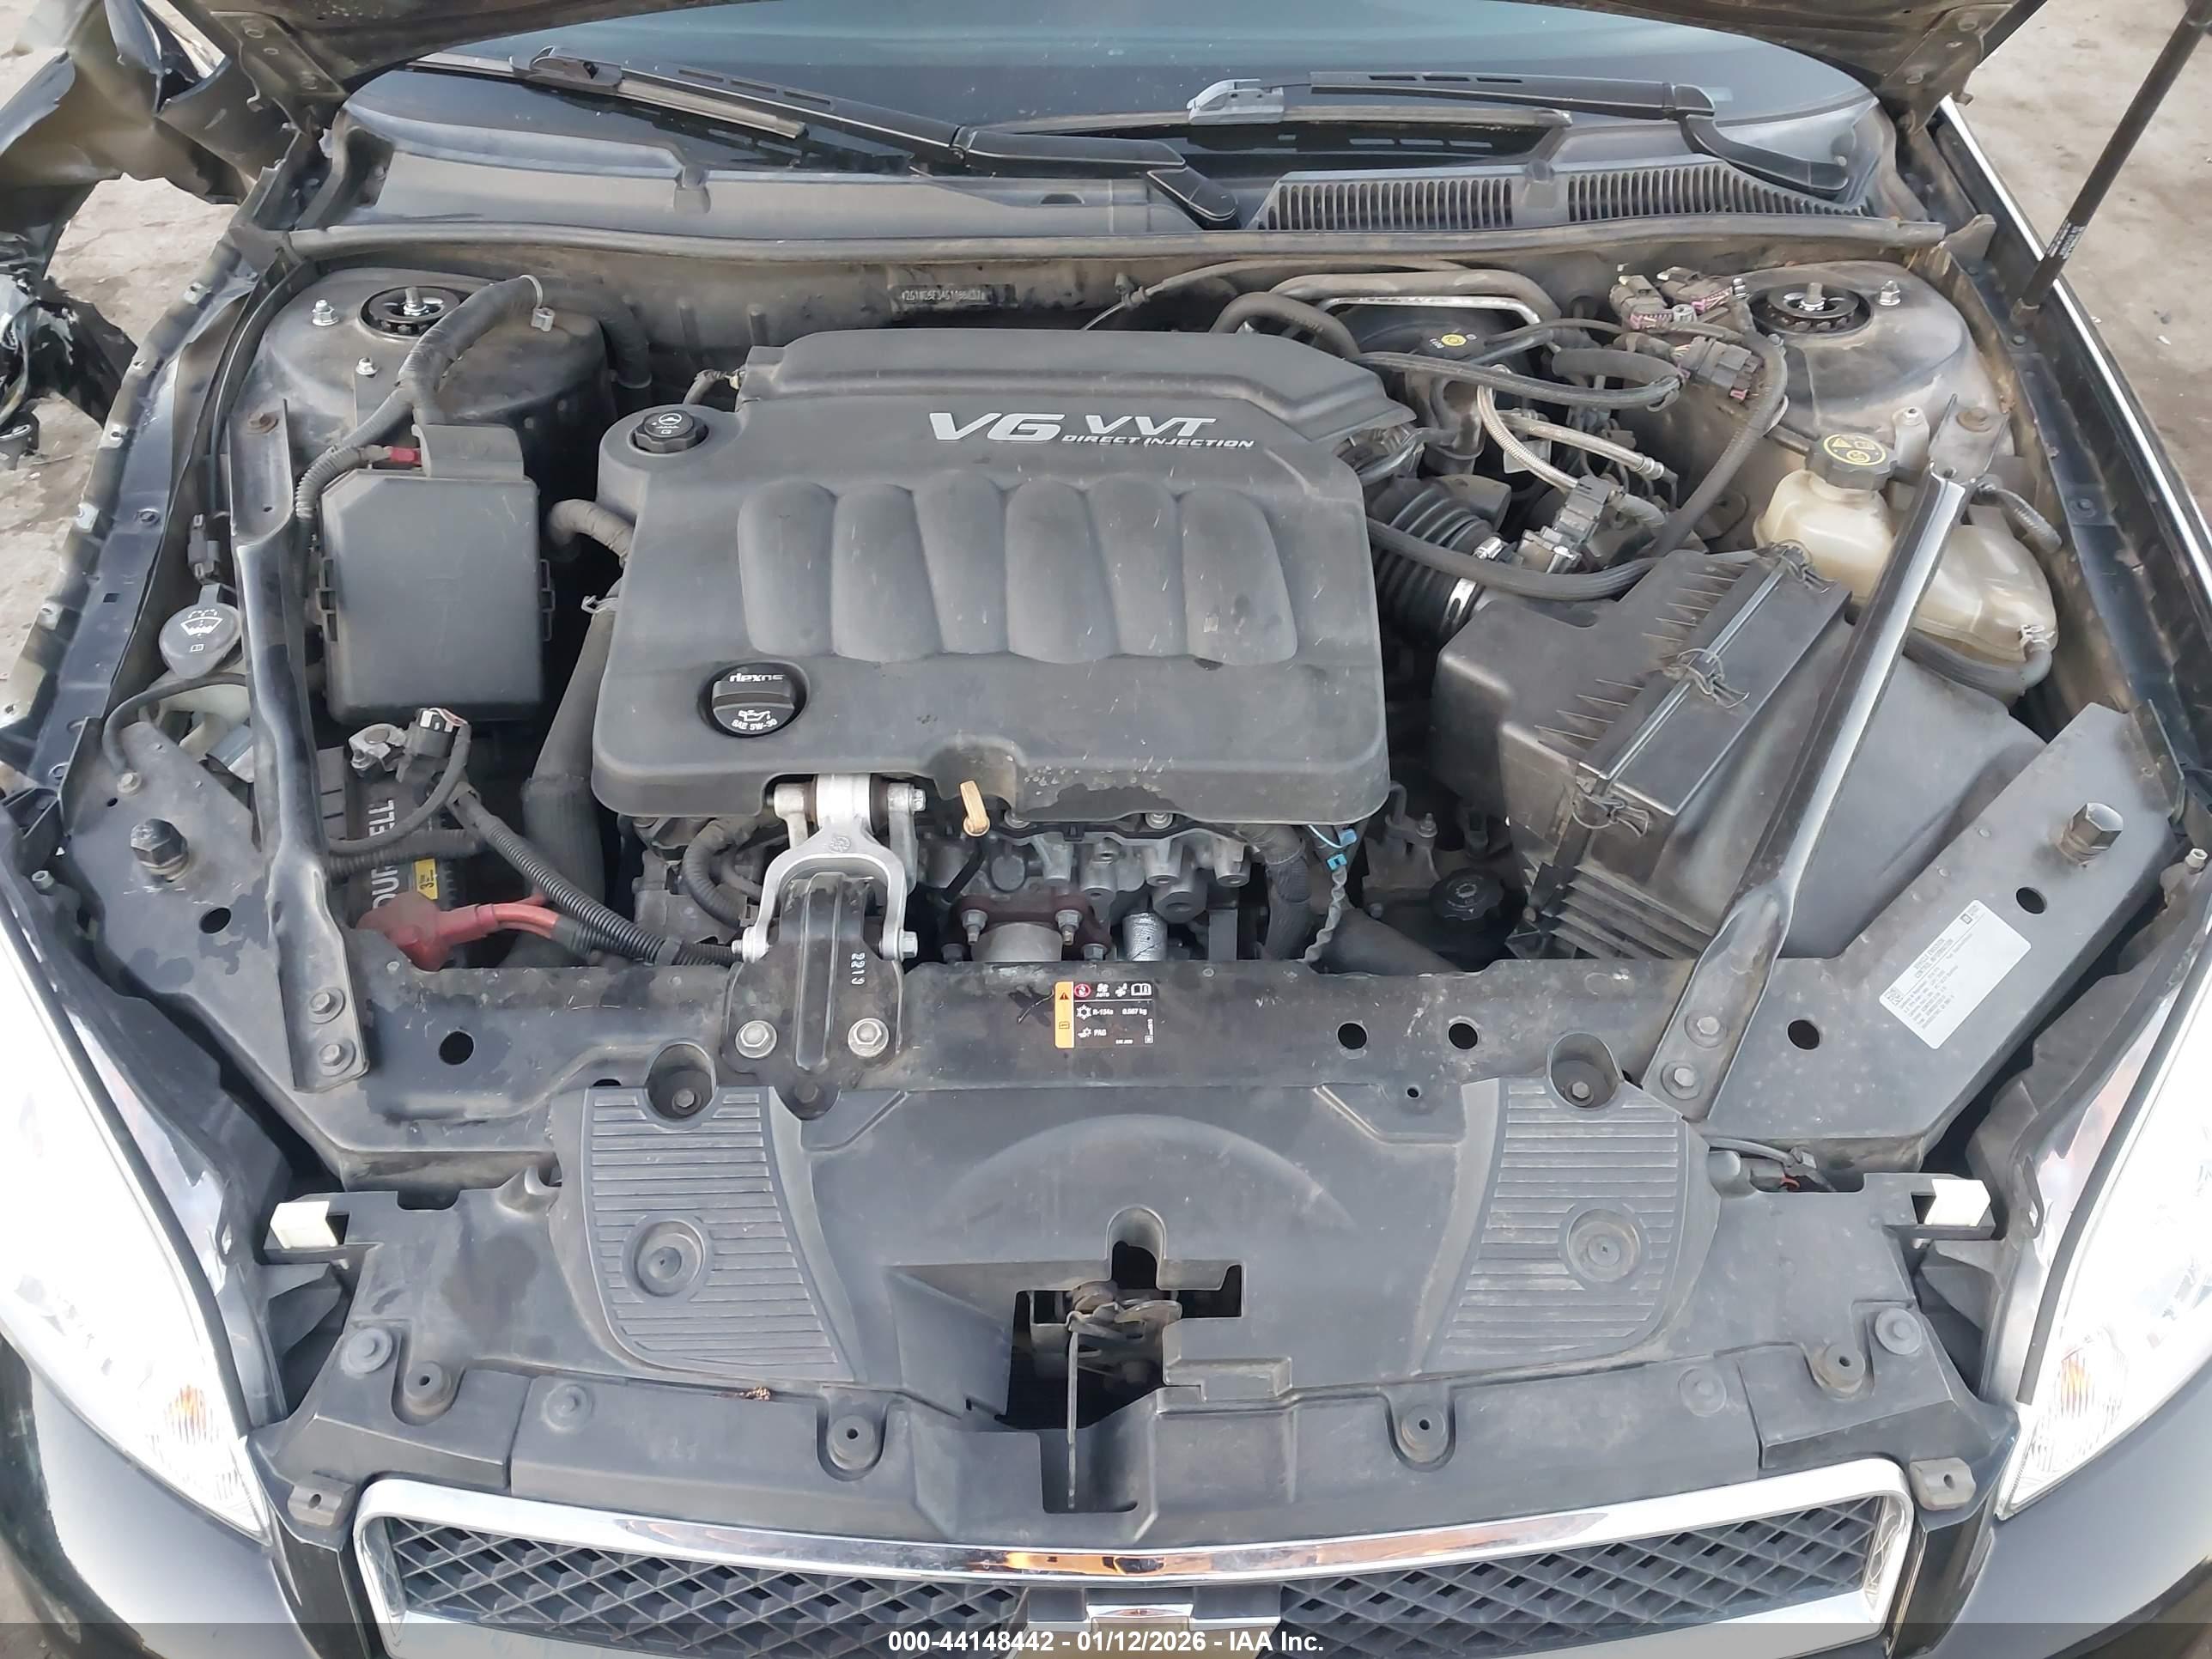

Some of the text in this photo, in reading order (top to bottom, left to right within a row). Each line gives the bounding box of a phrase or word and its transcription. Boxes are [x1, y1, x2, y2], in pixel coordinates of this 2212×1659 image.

[929, 412, 1217, 441] V6 VVT
[1061, 434, 1255, 448] DIRECT INJECTION
[731, 718, 778, 731] SAE 5W-30
